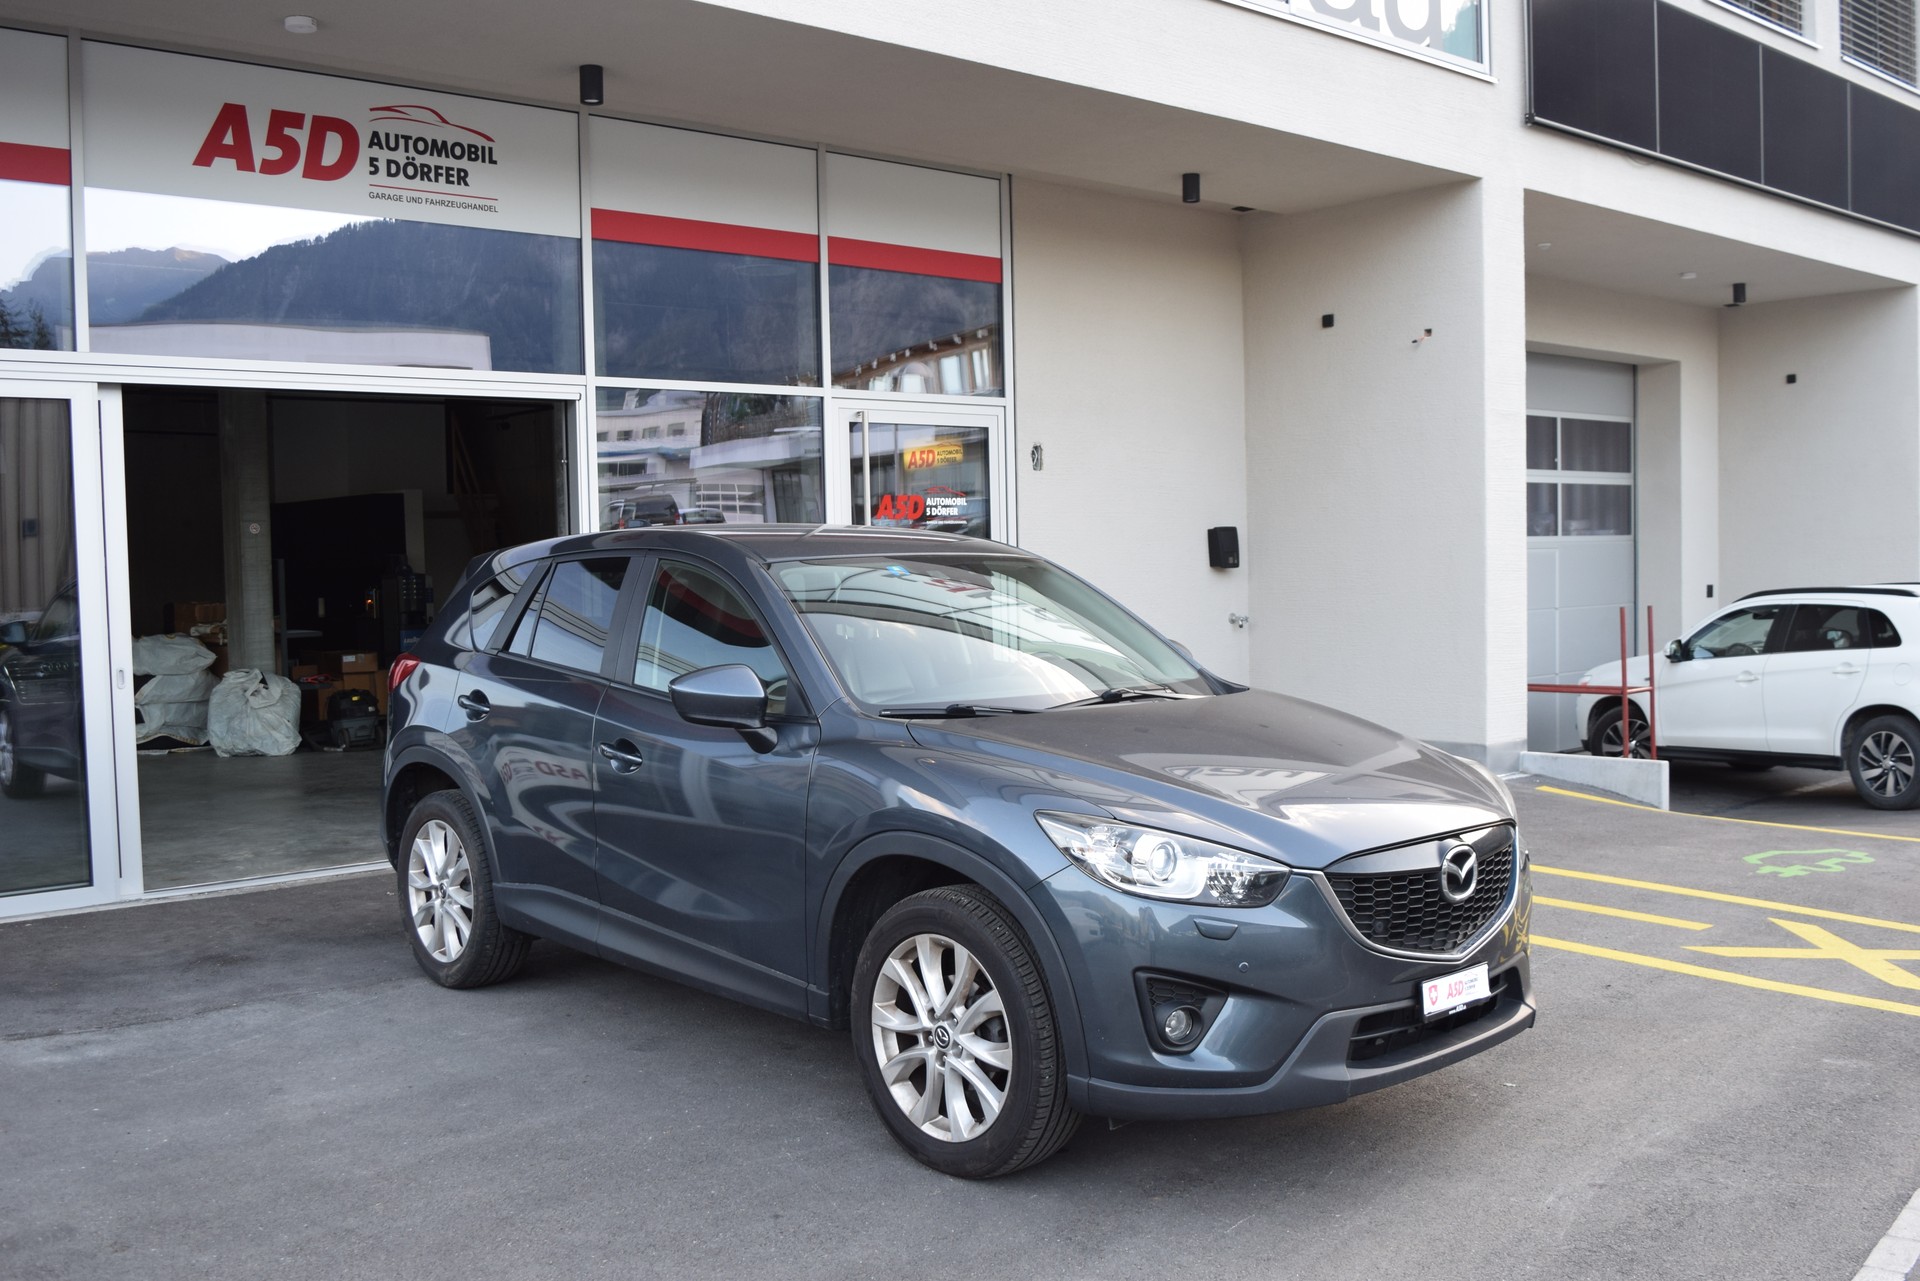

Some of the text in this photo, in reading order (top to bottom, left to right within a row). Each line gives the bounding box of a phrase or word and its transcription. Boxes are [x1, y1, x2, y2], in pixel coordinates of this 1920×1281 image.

[192, 102, 360, 182] A5D
[368, 130, 498, 165] AUTOMOBIL
[369, 156, 470, 187] 5 DÖRFER
[368, 191, 499, 213] GARAGE UND FAHRZEUGHANDEL
[908, 449, 936, 469] A5D
[876, 494, 925, 520] A5D
[926, 497, 967, 506] AUTOMOBIL
[926, 506, 959, 516] 5 DÖRFER
[1447, 980, 1464, 999] A5D
